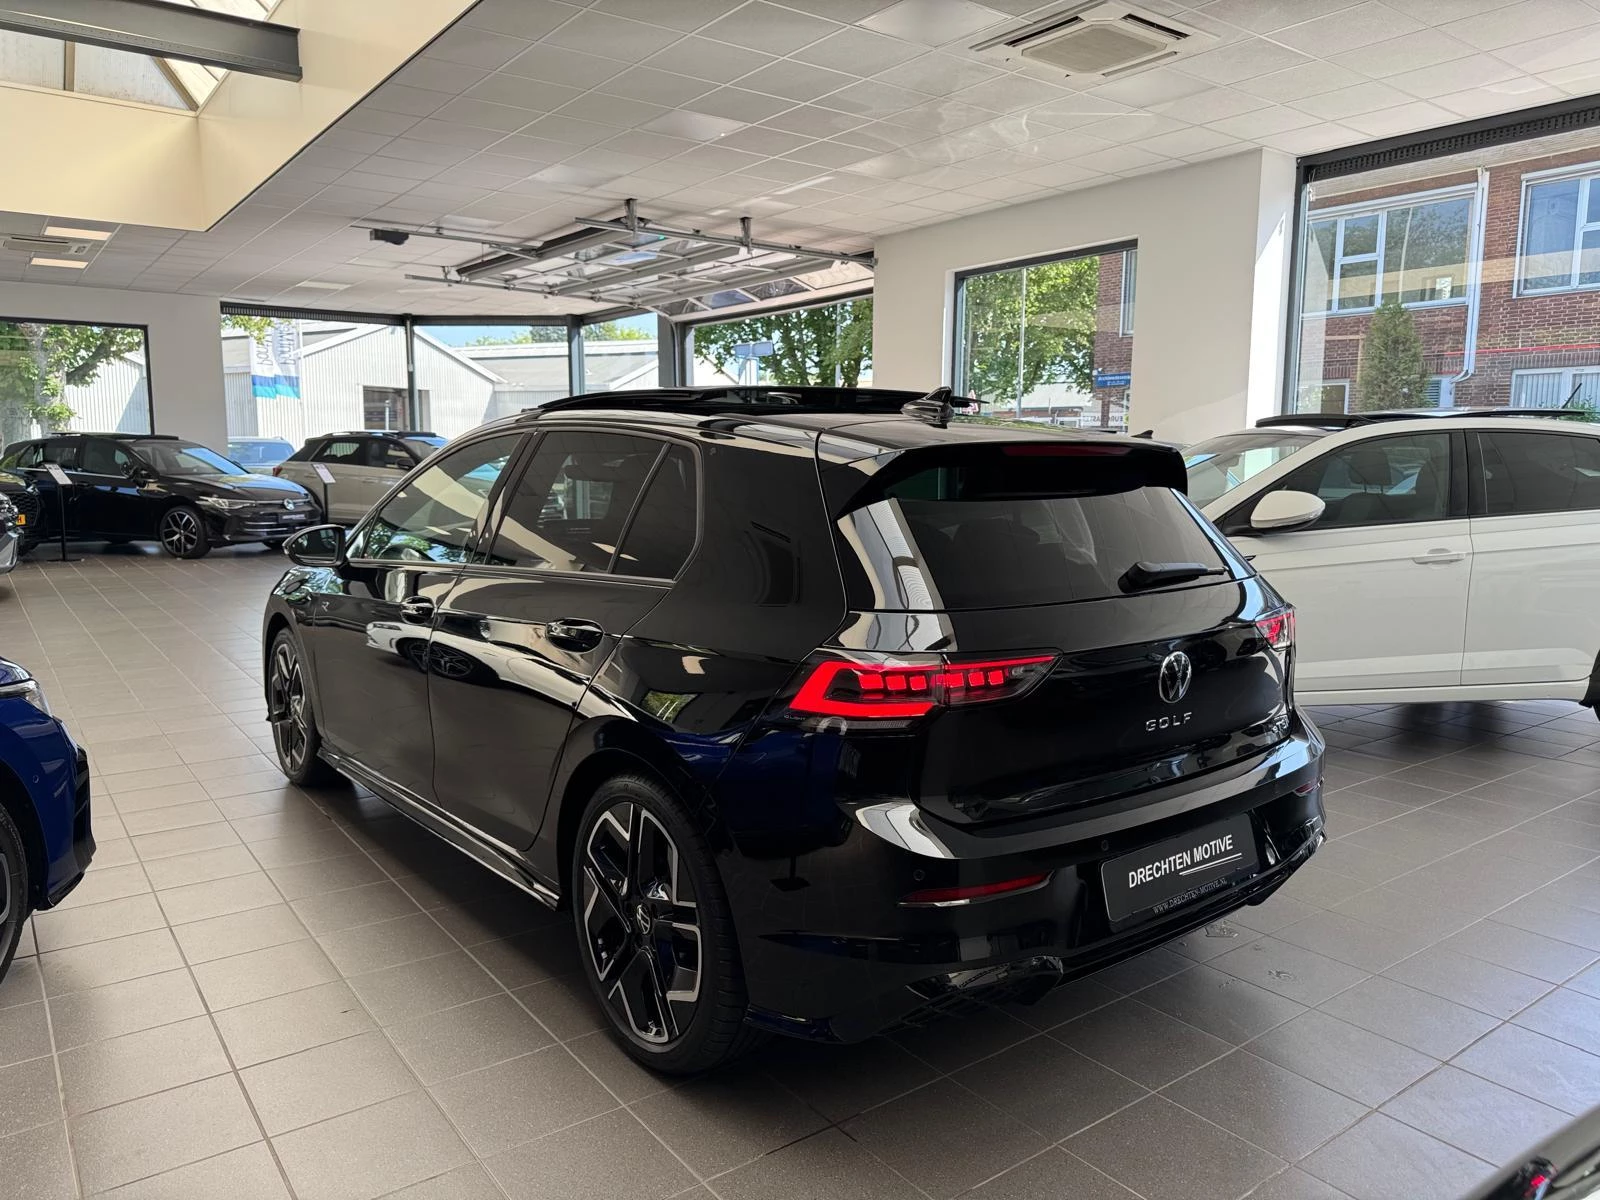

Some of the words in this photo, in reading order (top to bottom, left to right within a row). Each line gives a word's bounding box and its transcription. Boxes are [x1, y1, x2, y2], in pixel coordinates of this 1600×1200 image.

[1146, 712, 1192, 732] GOLF
[1128, 853, 1191, 889] DRECHTEN
[1193, 834, 1233, 862] MOTIVE
